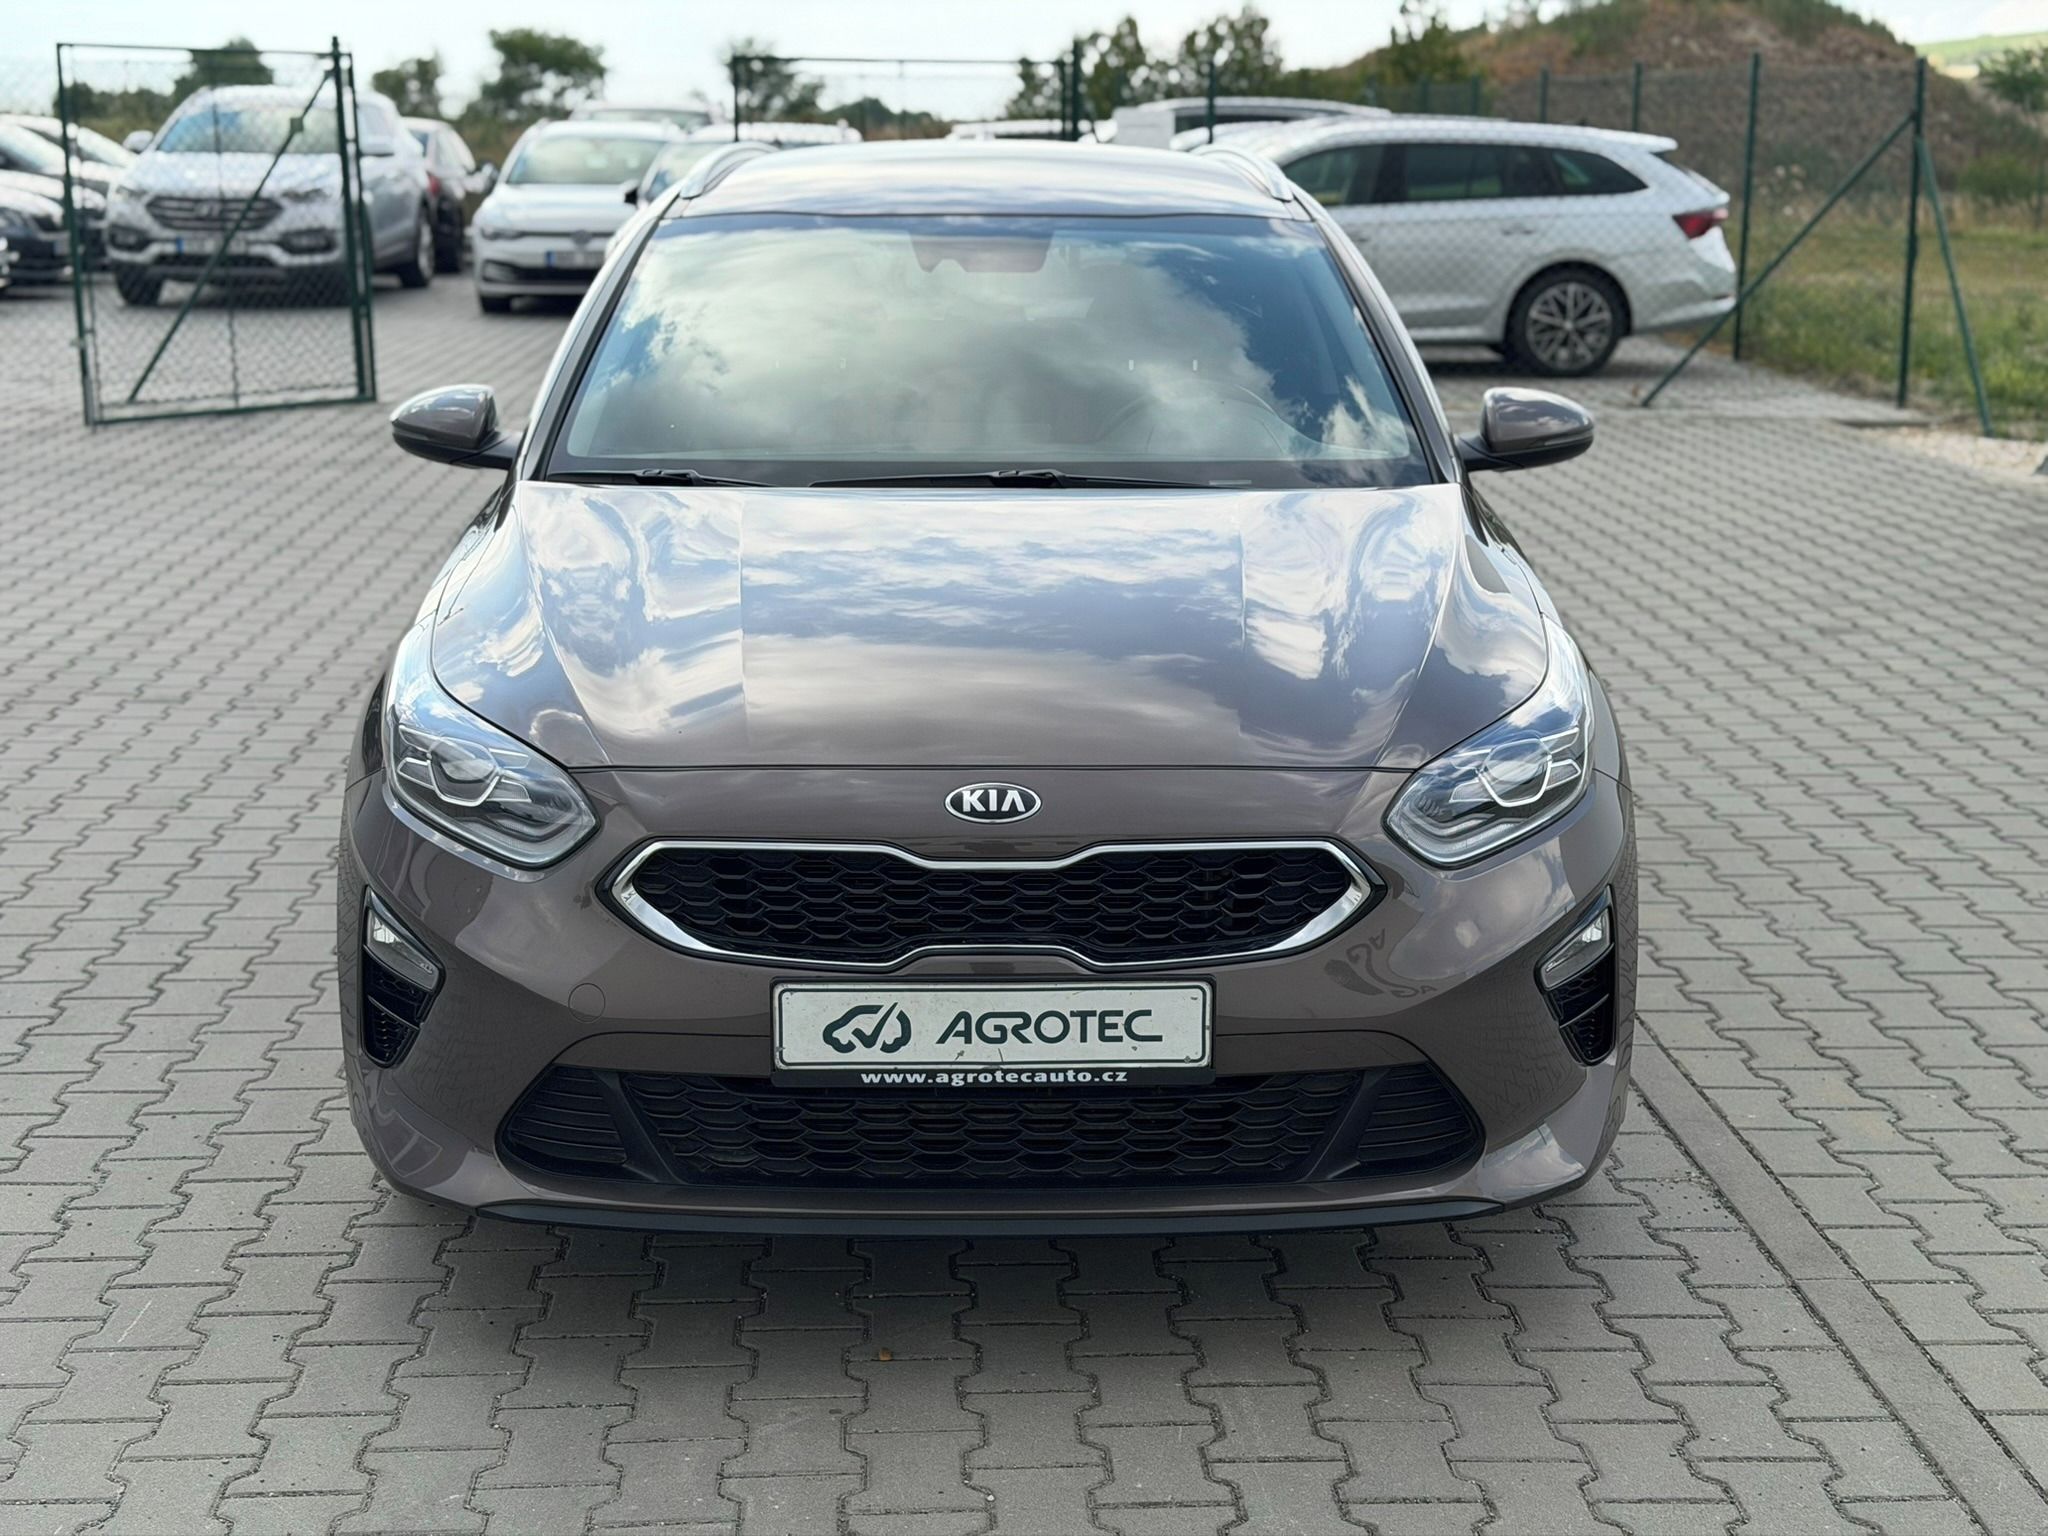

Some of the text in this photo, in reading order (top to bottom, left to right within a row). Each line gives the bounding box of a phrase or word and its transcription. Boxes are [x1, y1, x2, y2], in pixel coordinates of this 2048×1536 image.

[961, 789, 1026, 812] KIA
[936, 1010, 1163, 1045] AGROTEC
[861, 1069, 1128, 1087] www.agrotecauto.cz
